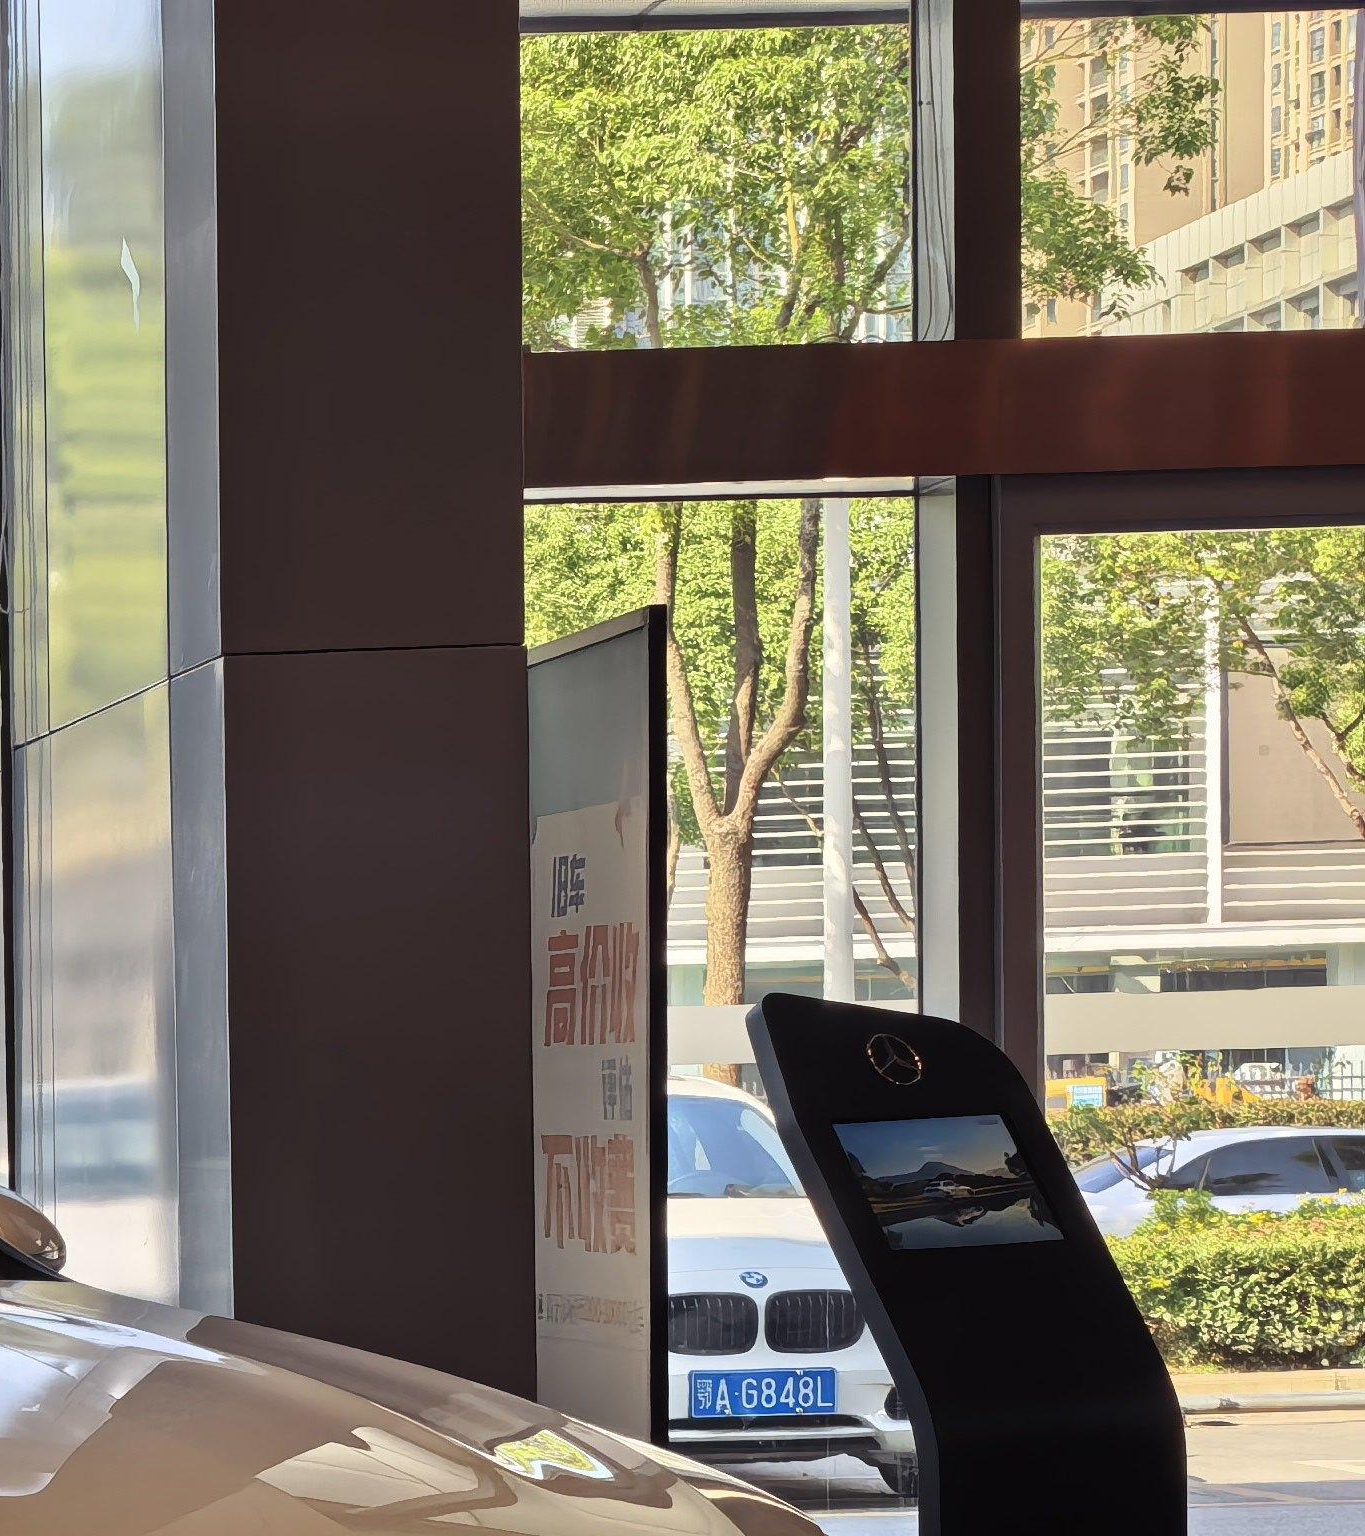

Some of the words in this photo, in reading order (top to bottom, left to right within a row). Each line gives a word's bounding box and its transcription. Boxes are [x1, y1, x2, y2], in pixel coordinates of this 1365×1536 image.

[551, 854, 587, 918] 旧车
[544, 923, 640, 1047] 高价收
